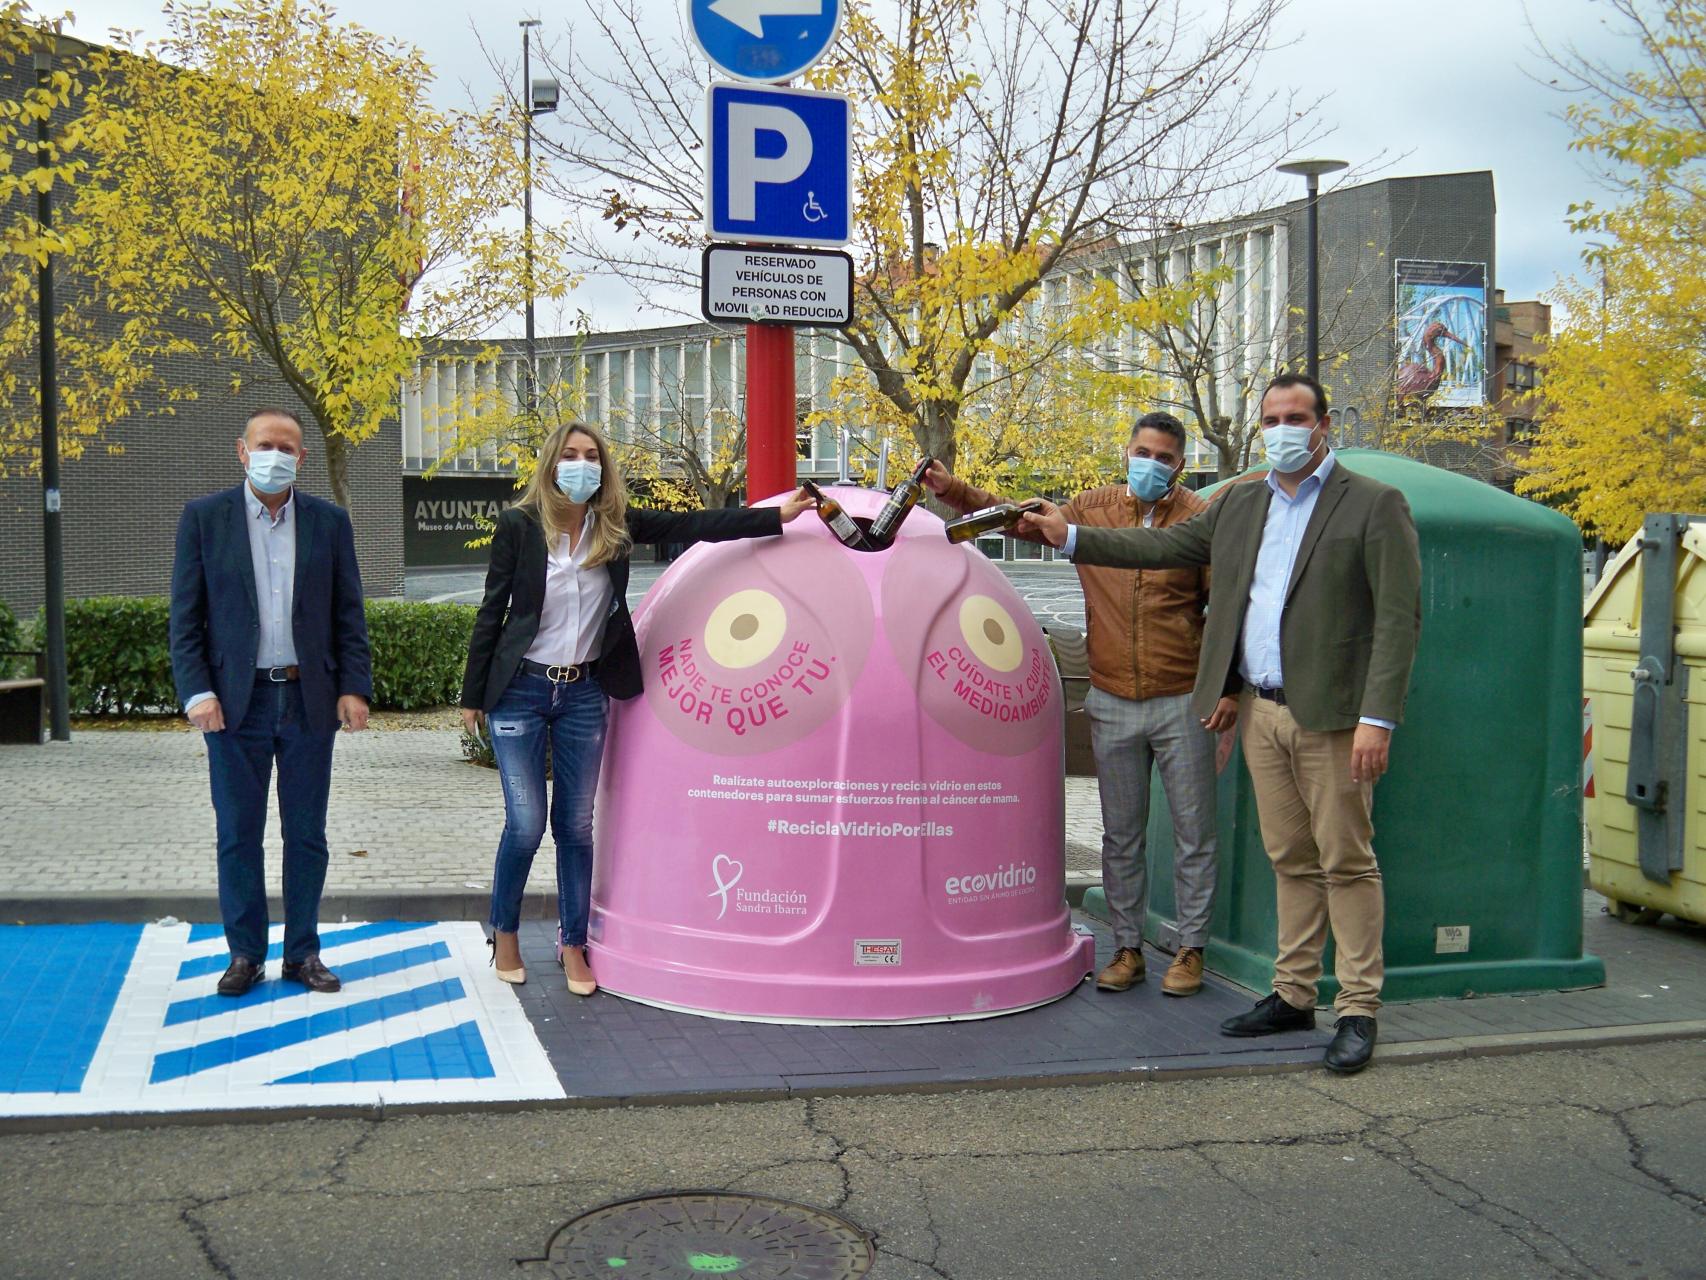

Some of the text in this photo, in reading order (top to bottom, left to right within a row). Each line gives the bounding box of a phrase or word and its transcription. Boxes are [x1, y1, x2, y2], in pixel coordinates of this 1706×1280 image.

[728, 102, 813, 221] P
[745, 255, 816, 270] RESERVADO
[735, 270, 823, 286] VEHÍCULOS DE
[732, 286, 826, 302] PERSONAS CON
[714, 302, 844, 319] MOVILAD REDUCIDA
[418, 521, 442, 531] Museo
[444, 521, 453, 531] de
[455, 521, 474, 531] Arte
[679, 638, 810, 704] NADIE TE CONOCE
[927, 651, 949, 681] EL
[948, 647, 1040, 700] CUÍDATE Y CUIDA
[658, 645, 836, 736] MEJOR QUE TU.
[713, 774, 765, 787] Realízate
[767, 778, 879, 791] autoexploraciones
[882, 782, 889, 793] y
[929, 780, 961, 791] vidrio
[963, 782, 976, 791] en
[977, 781, 1002, 791] estos
[687, 788, 1020, 805] contenedores para sumar esfuerzos frente al cáncer de mama.
[767, 819, 954, 837] #ReciclaVidrioPorEllas
[945, 860, 1036, 895] ecovidrio
[736, 888, 807, 903] Fundación
[948, 895, 978, 905] ENTIDAD
[736, 902, 807, 915] Sandra Ibarra
